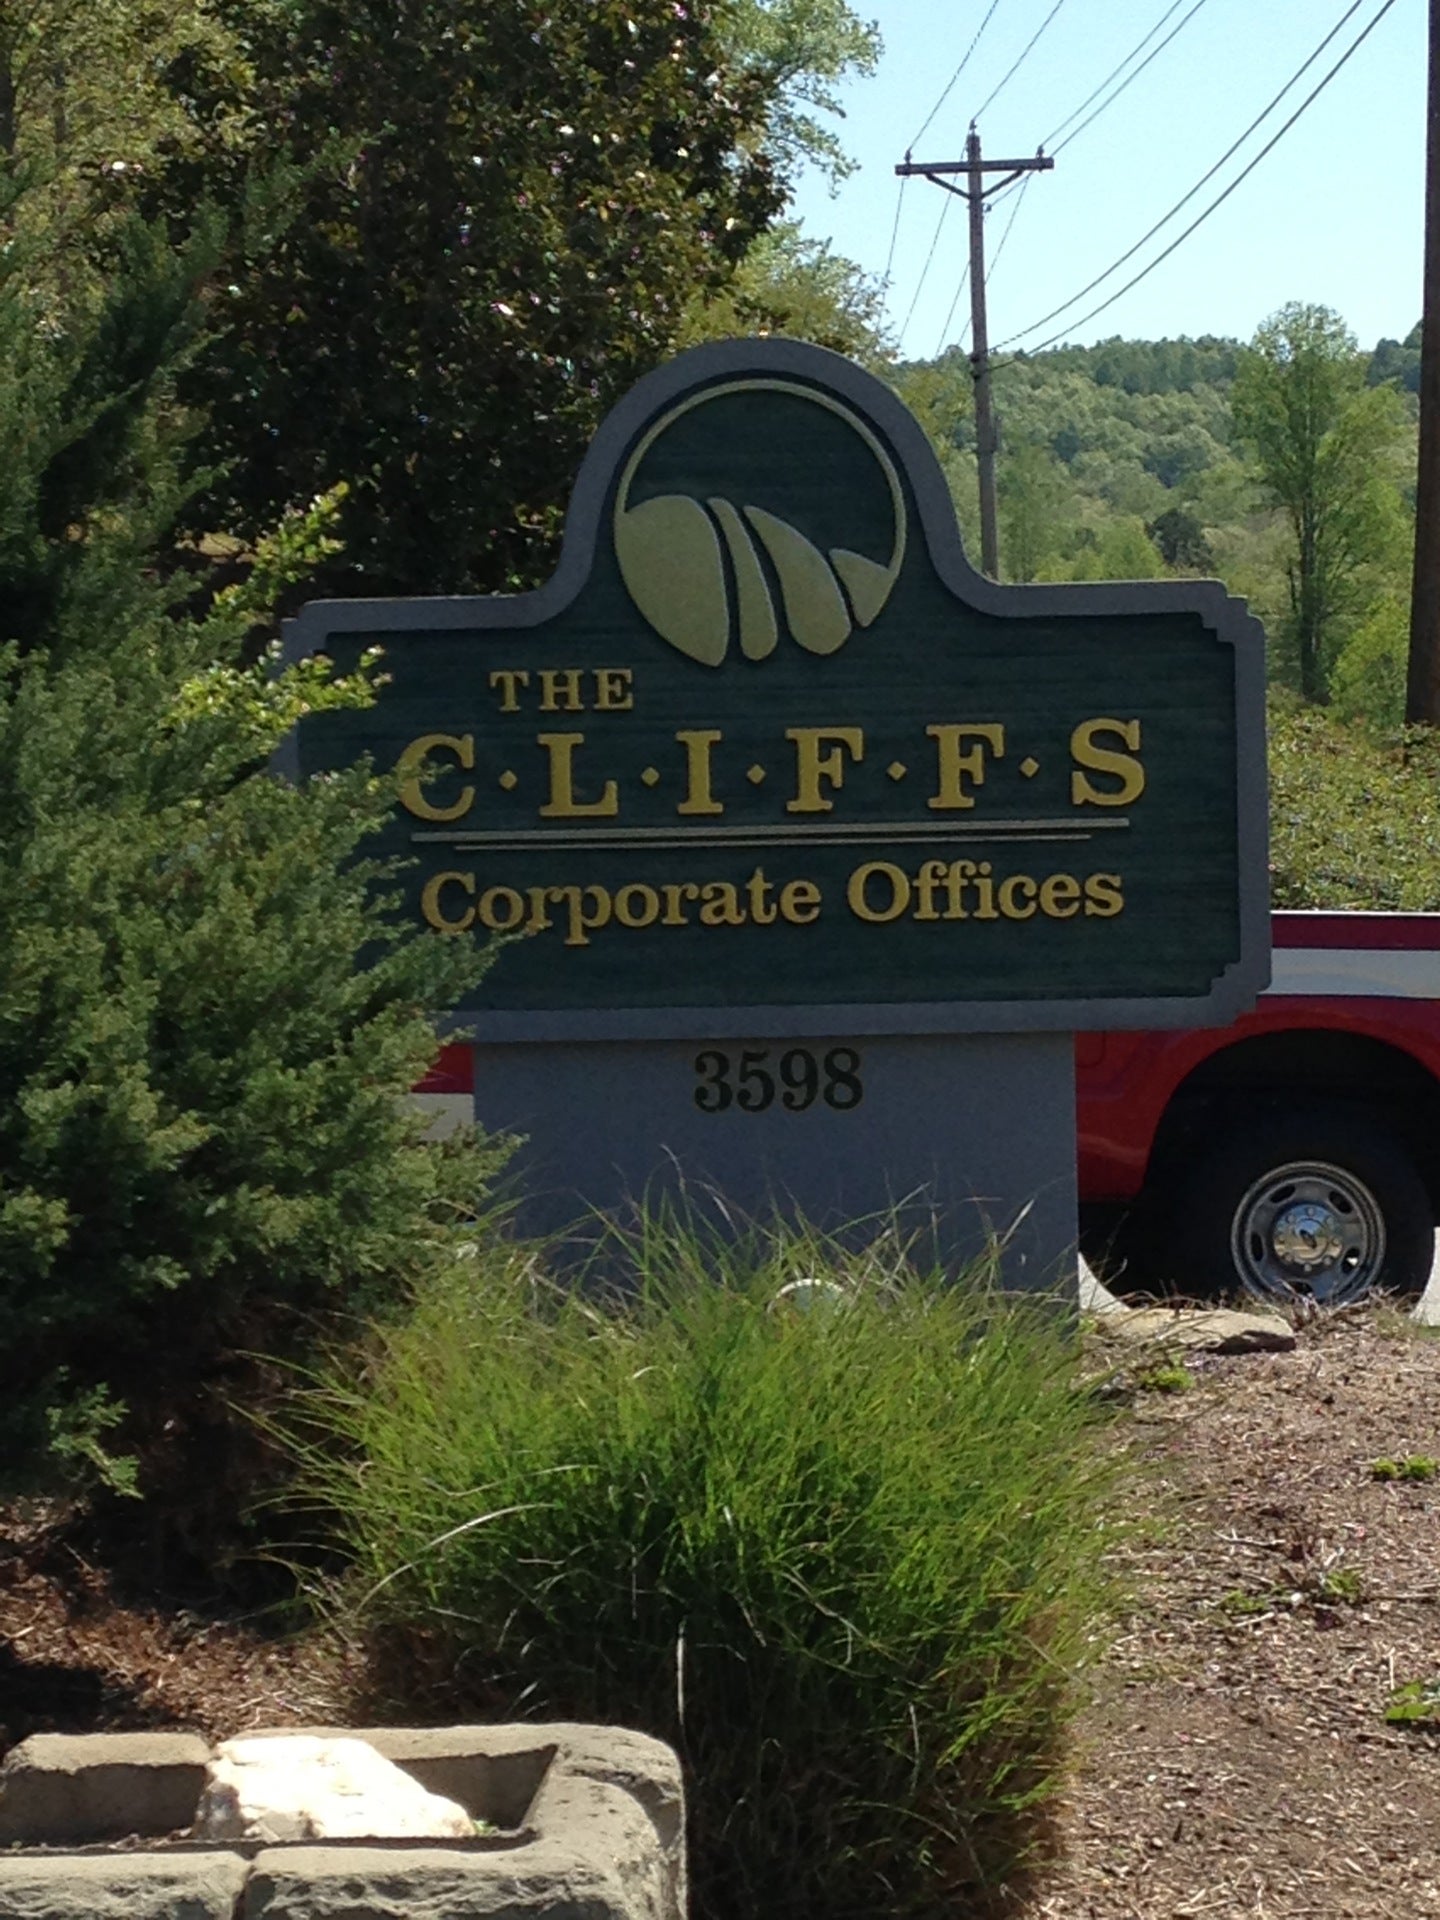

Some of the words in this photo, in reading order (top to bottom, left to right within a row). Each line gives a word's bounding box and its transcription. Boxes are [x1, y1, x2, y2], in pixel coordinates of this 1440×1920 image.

[490, 669, 634, 711] THE
[421, 867, 822, 945] Corporate
[847, 860, 1124, 923] Offices
[694, 1047, 864, 1113] 3598
